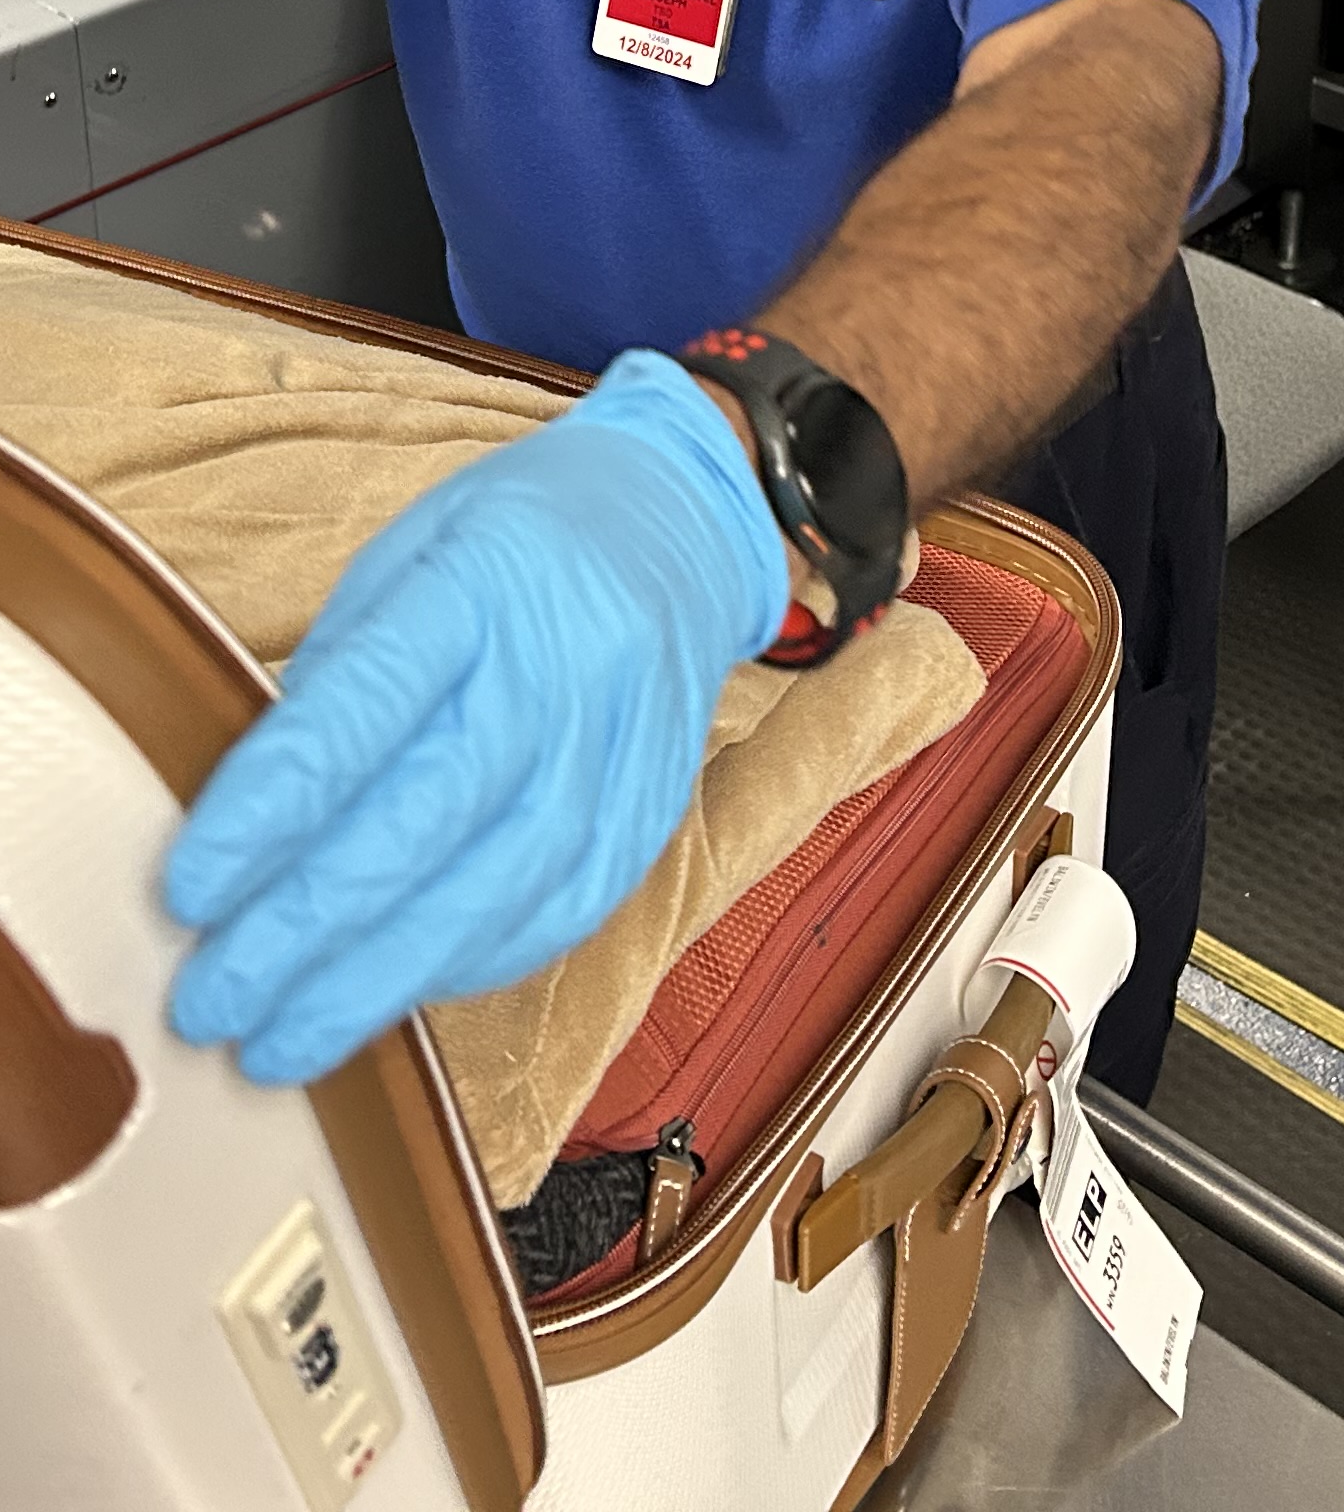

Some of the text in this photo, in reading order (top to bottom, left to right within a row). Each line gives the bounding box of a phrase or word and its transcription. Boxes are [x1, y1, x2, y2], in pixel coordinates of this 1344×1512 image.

[619, 36, 692, 70] 12/8/2024
[1075, 1177, 1105, 1251] ELP
[1103, 1235, 1126, 1291] 3359
